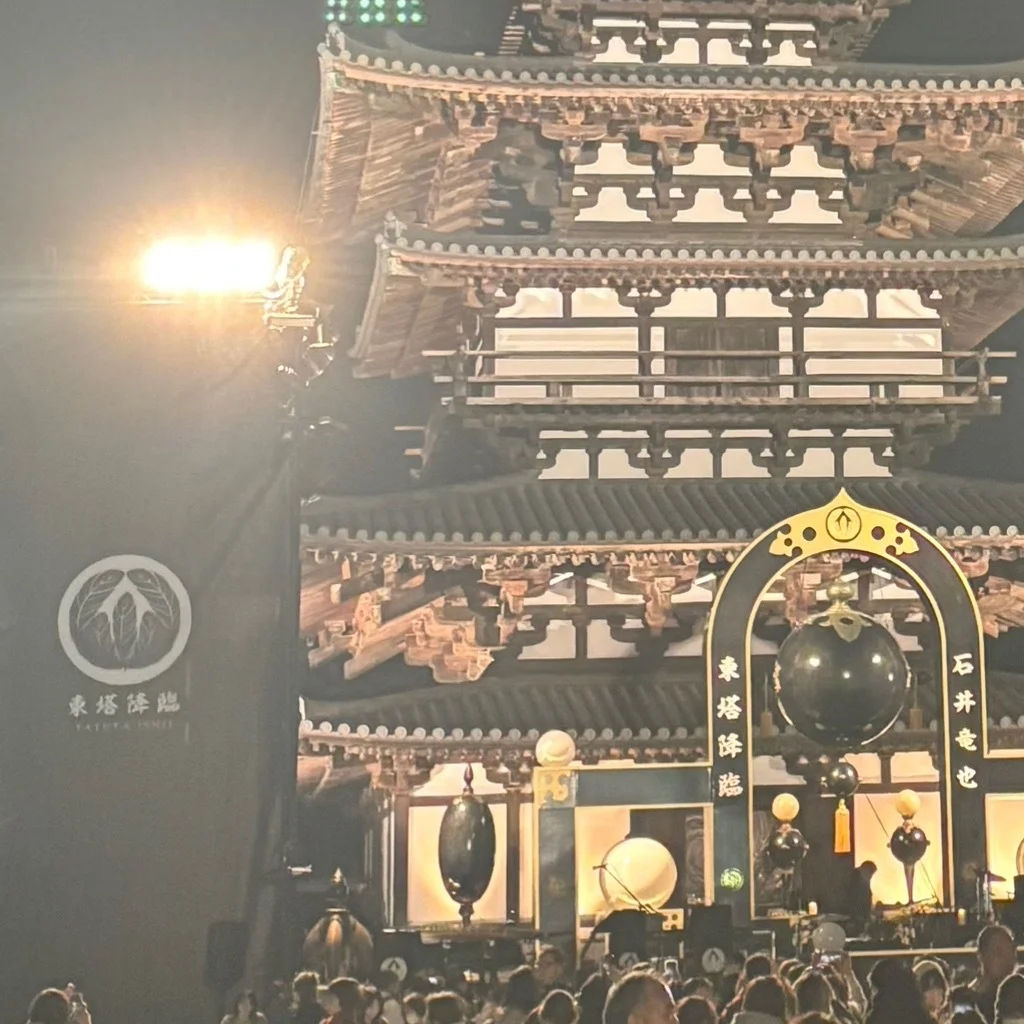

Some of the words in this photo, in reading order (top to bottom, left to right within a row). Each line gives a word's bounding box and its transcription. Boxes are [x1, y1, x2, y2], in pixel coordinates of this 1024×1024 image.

[717, 655, 744, 797] 東塔降臨
[952, 653, 978, 788] 石井竜也
